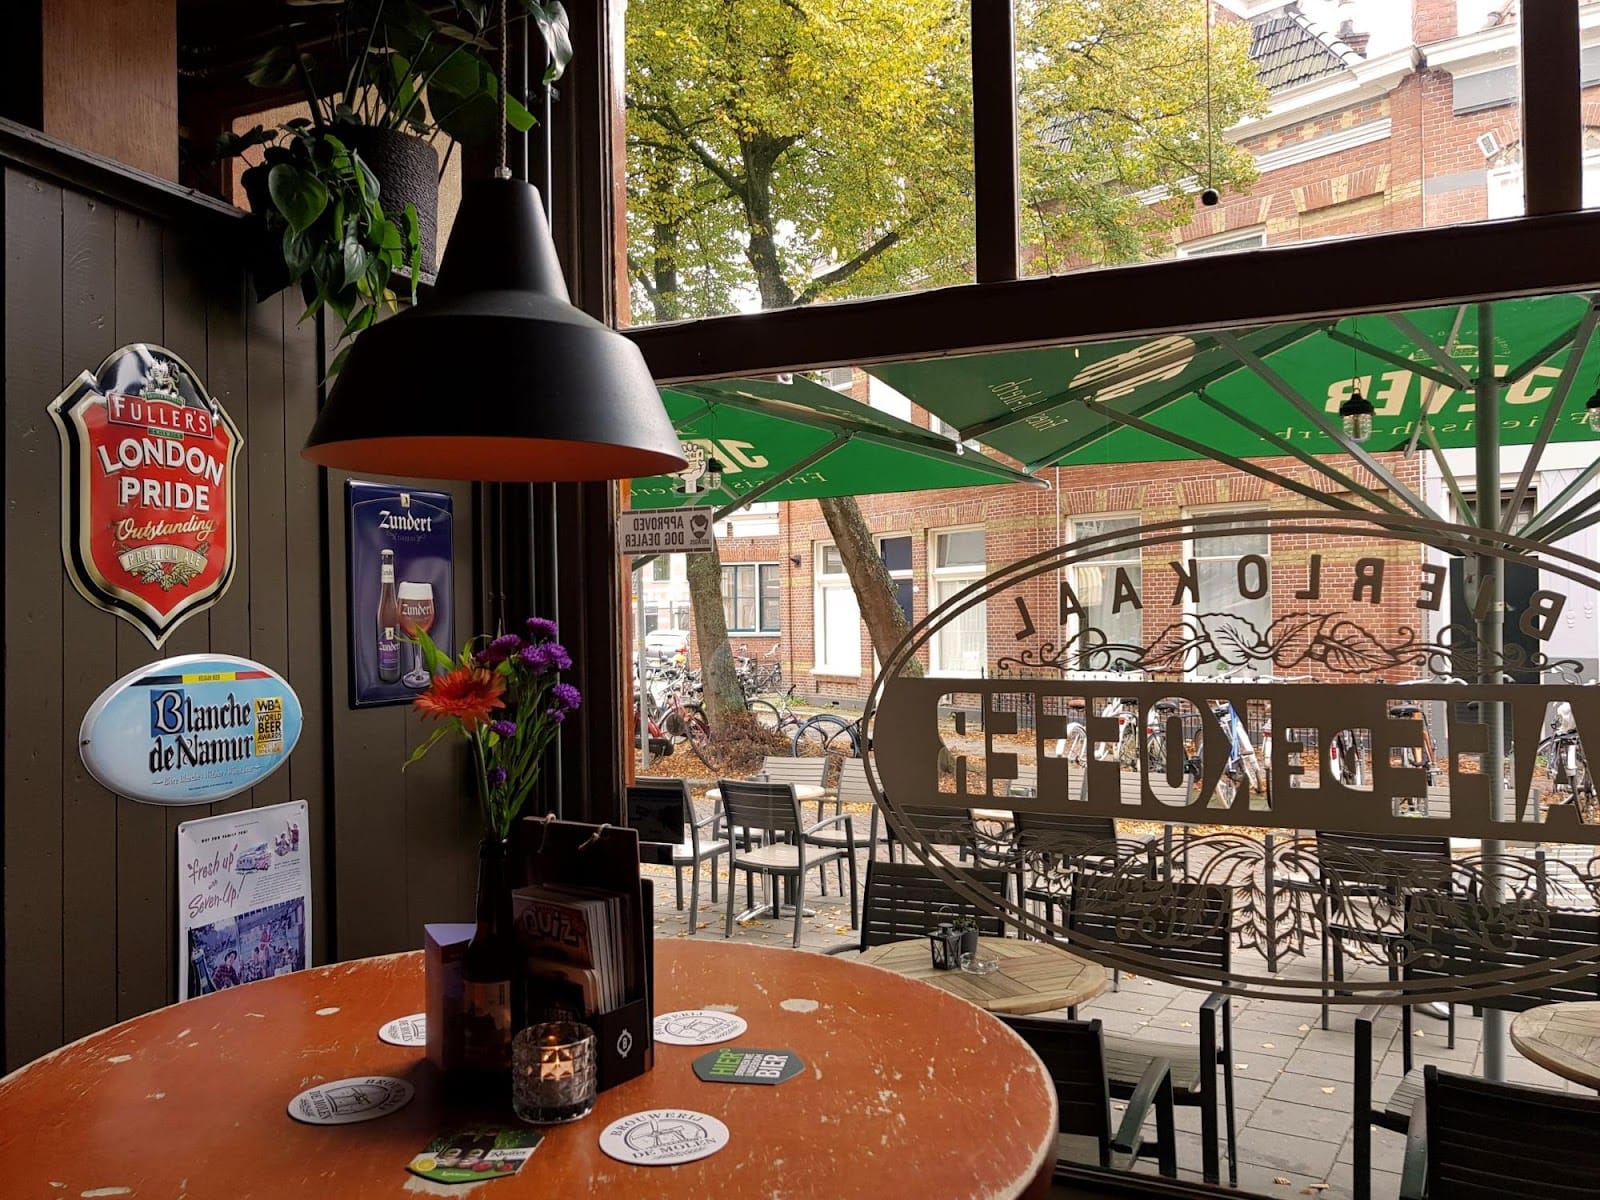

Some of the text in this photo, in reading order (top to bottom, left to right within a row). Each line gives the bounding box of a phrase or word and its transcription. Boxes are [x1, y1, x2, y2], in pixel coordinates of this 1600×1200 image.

[111, 397, 207, 432] FULLER'S
[98, 438, 224, 487] LONDON
[120, 476, 210, 512] PRIDE
[115, 514, 216, 541] Outstanding
[378, 509, 433, 532] Zundert
[153, 689, 251, 735] Blanche
[257, 699, 281, 711] WBA
[257, 713, 281, 722] WORLD
[257, 719, 281, 733] BEER
[175, 734, 253, 770] Namur
[755, 1054, 789, 1078] BIER
[610, 1111, 705, 1137] BROUWERIJ
[660, 1137, 717, 1154] MOLEN
